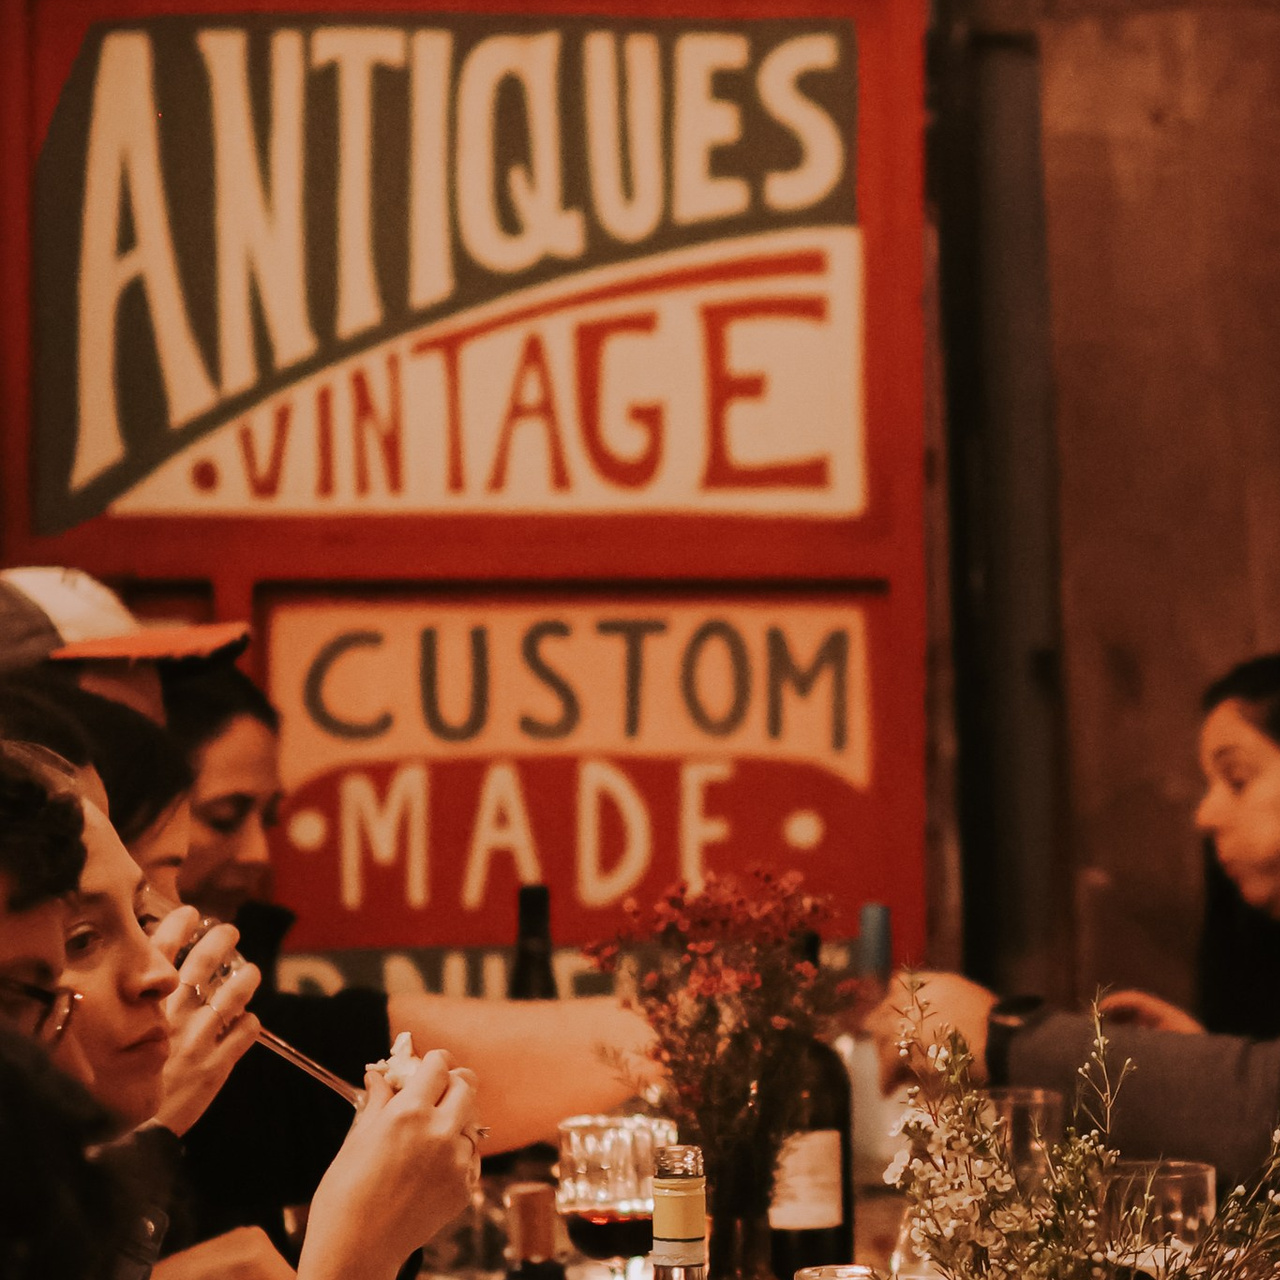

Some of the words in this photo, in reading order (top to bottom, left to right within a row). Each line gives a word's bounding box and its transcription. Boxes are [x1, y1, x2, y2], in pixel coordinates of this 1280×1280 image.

[69, 30, 846, 493] ANTIQUES
[237, 291, 830, 496] VINTAGE
[304, 619, 851, 753] CUSTOM
[340, 761, 736, 910] MADE
